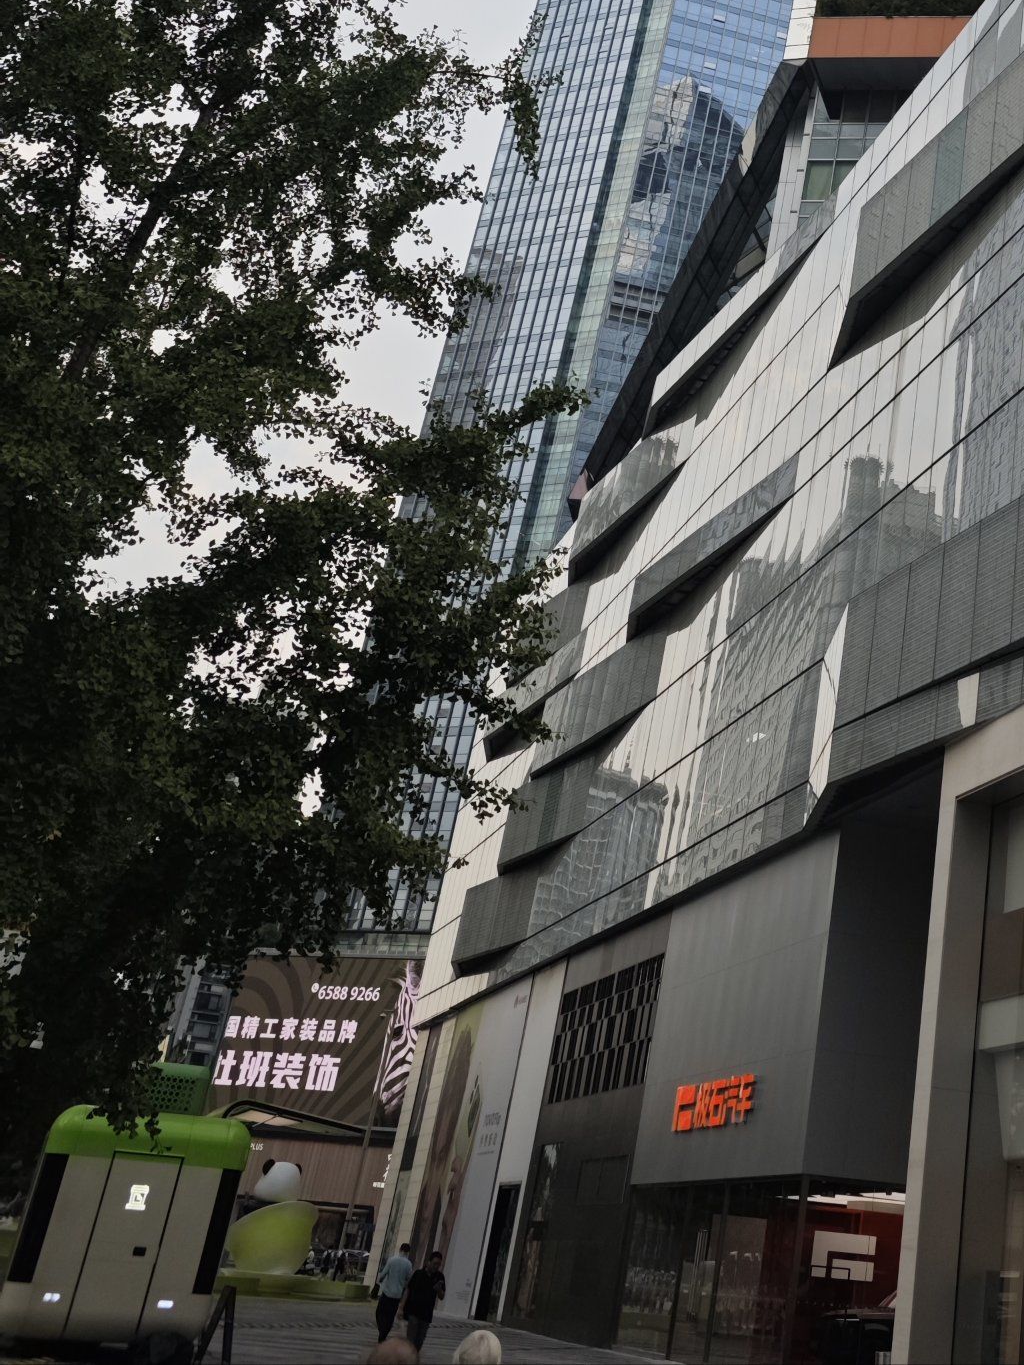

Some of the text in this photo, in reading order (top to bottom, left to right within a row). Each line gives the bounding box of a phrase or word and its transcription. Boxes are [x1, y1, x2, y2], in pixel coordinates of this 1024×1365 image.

[317, 985, 380, 1002] 6588 9266
[224, 1015, 358, 1043] 国精工家装品牌
